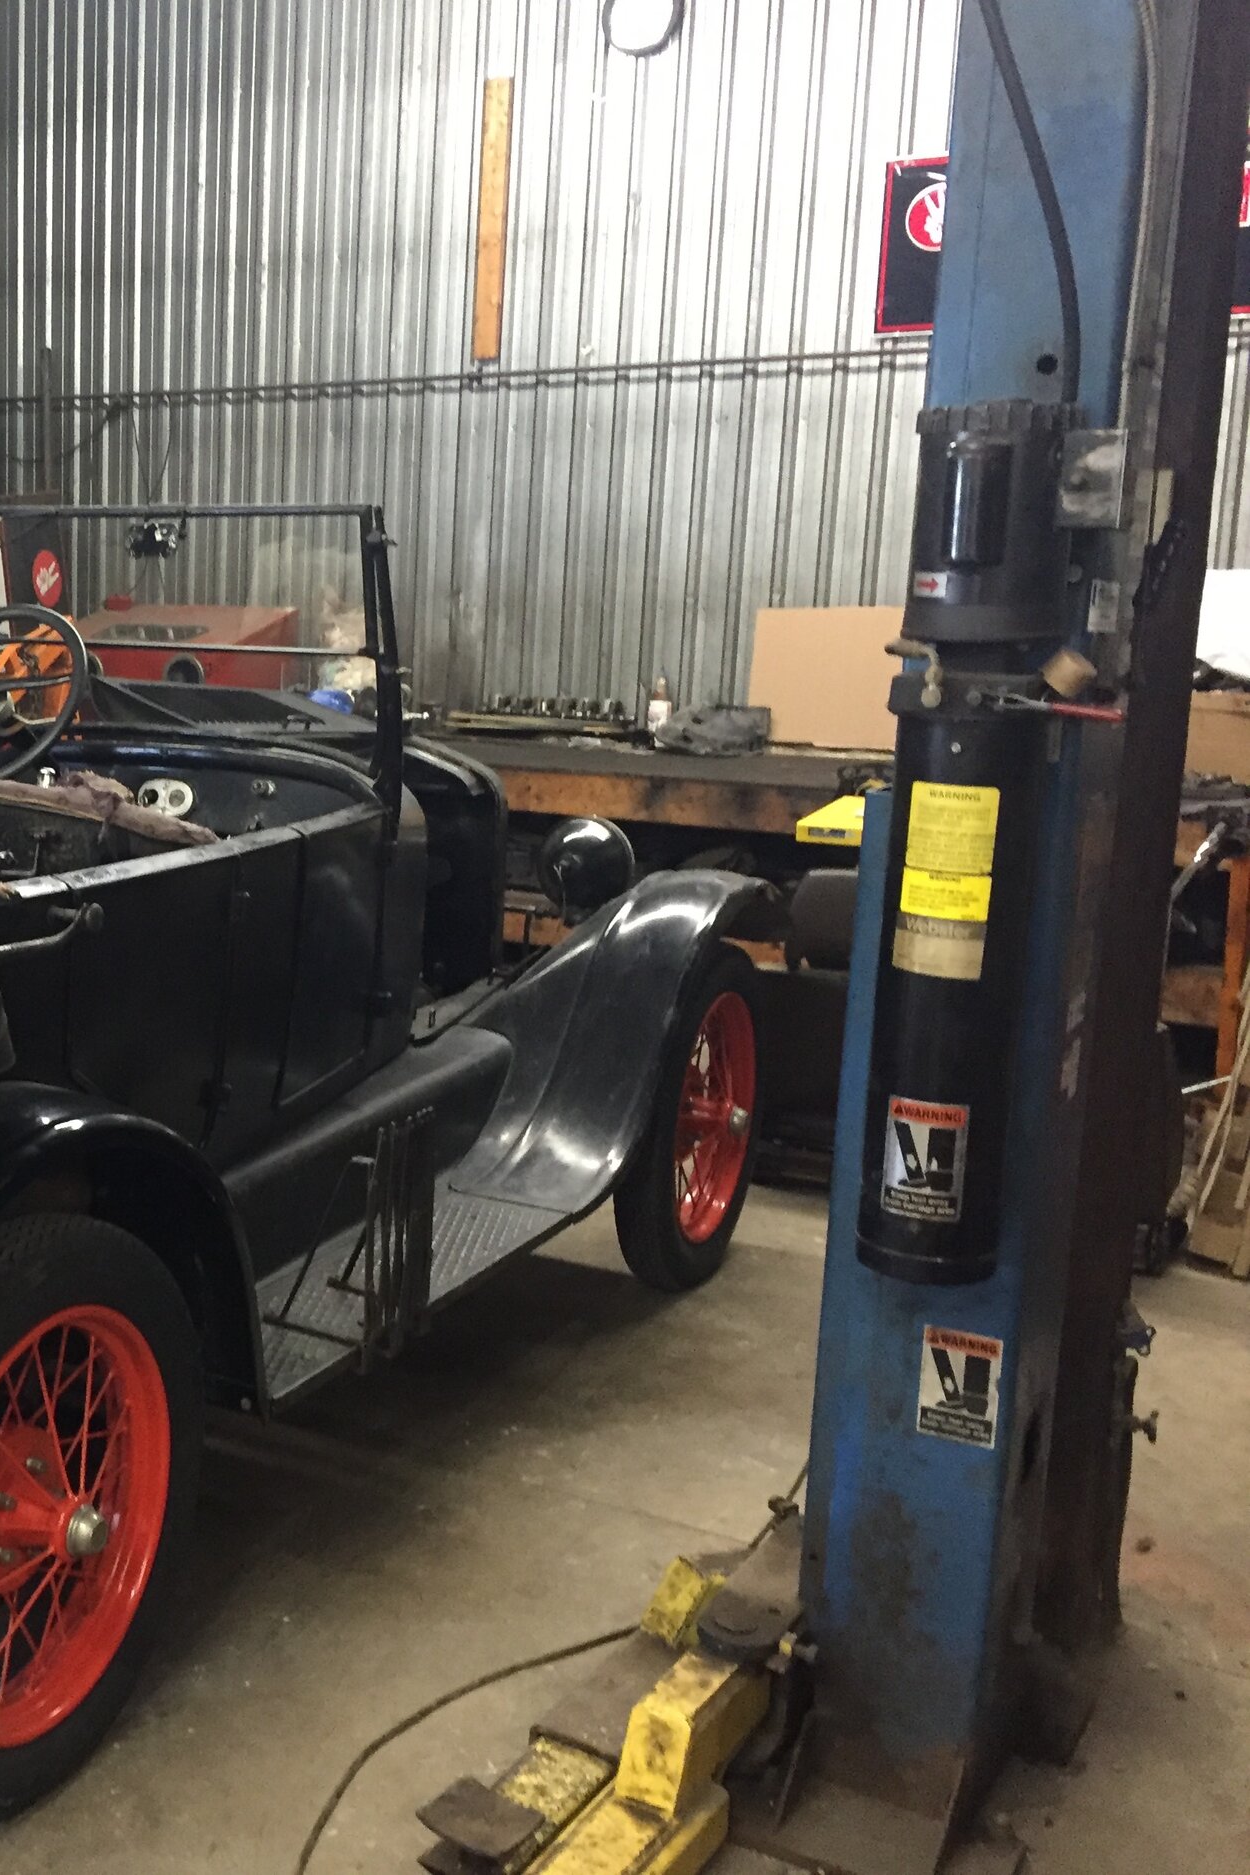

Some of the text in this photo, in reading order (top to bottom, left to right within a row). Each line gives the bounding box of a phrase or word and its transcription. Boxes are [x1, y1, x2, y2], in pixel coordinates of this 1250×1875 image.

[929, 788, 981, 802] WARNING
[904, 1104, 962, 1123] WARNING
[941, 1333, 998, 1355] WARNING
